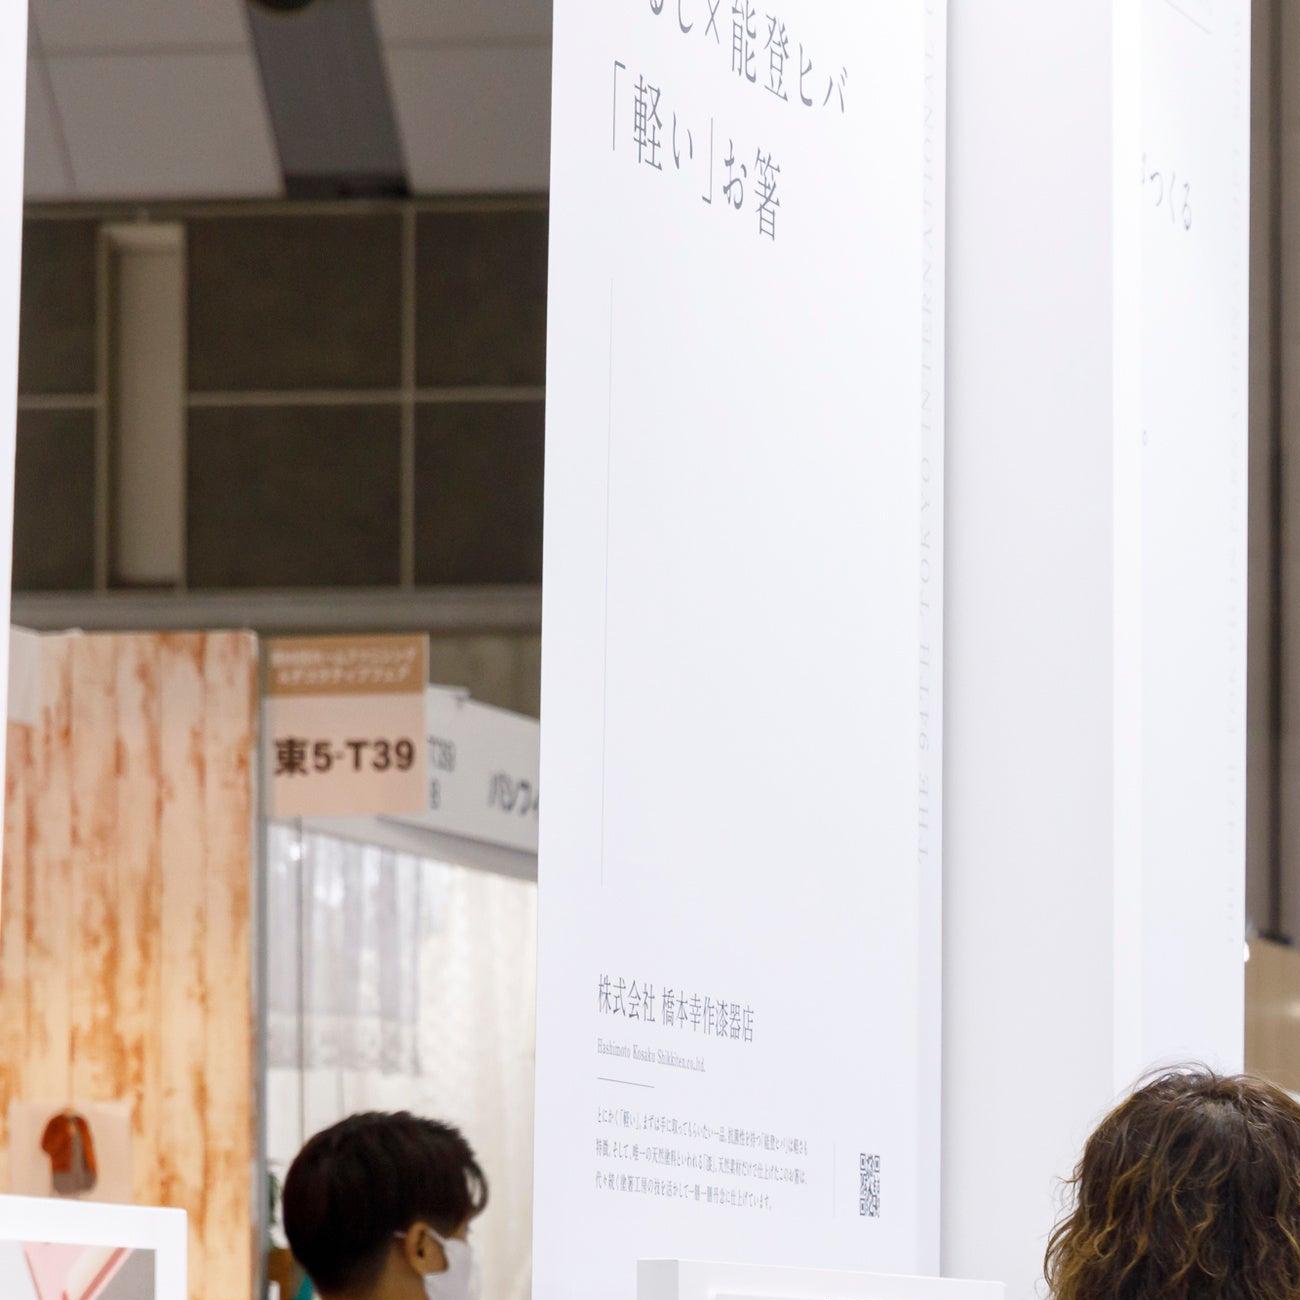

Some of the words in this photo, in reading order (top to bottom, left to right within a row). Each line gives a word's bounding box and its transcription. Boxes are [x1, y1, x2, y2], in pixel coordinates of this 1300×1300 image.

[613, 60, 780, 240] 「軽い」お箸
[274, 736, 415, 776] 東5-T39
[598, 973, 655, 1023] 株式会社
[661, 987, 755, 1042] 橋本幸作漆器店
